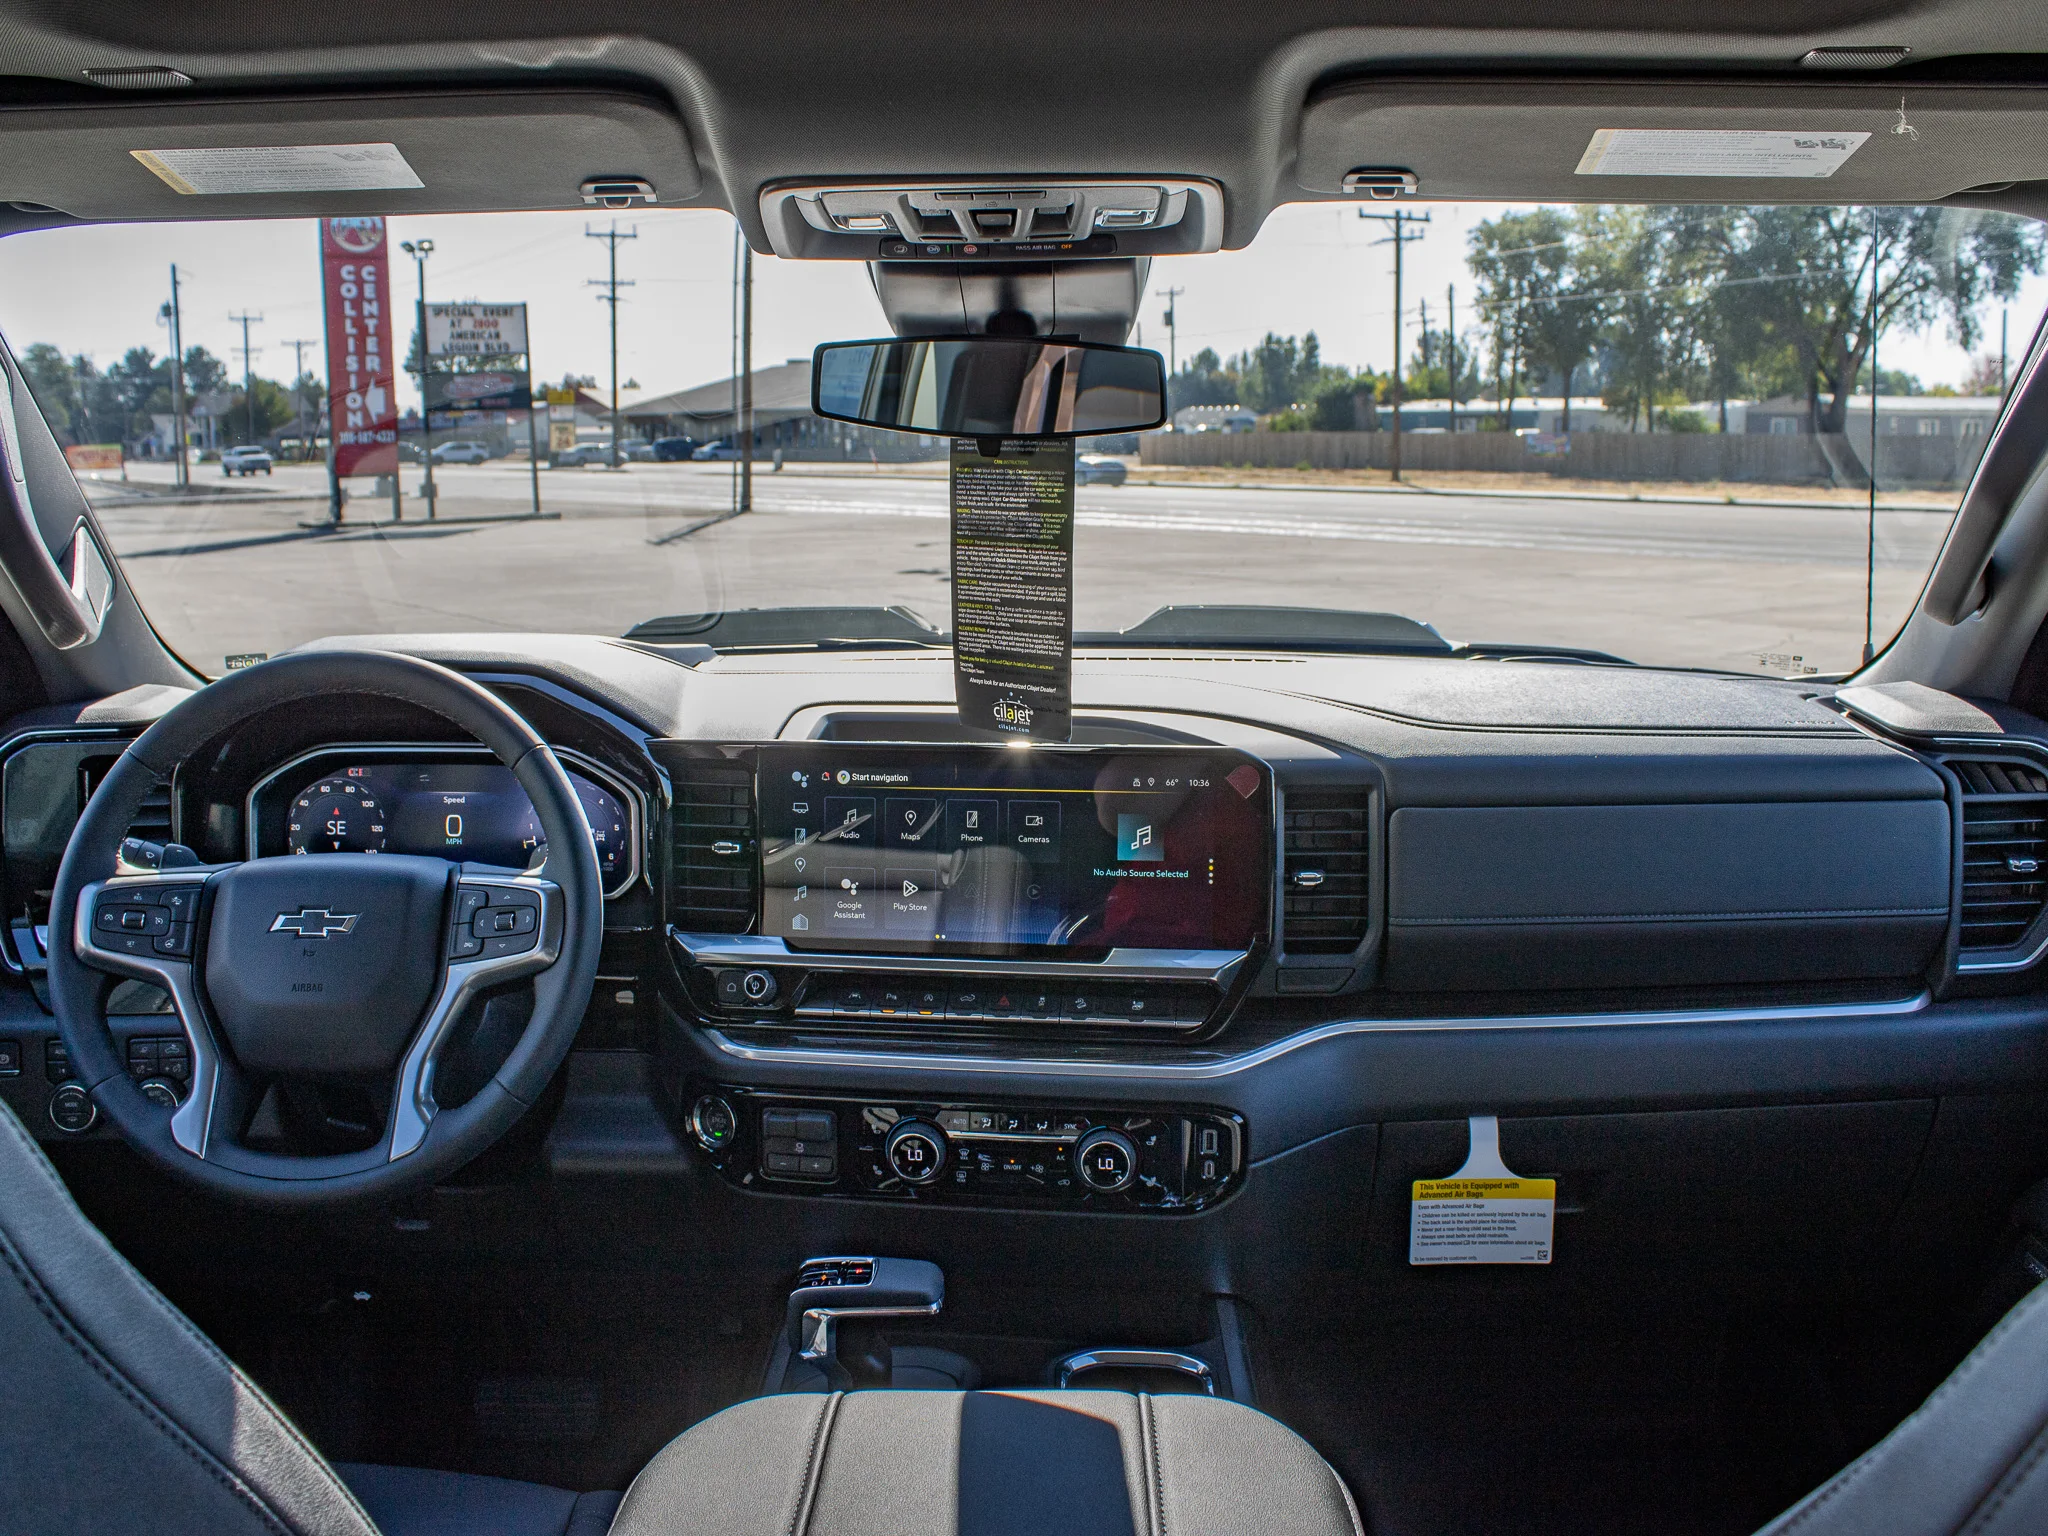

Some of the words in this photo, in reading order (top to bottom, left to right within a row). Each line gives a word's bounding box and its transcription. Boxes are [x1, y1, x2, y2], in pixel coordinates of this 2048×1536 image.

[432, 307, 475, 317] SPECIAL
[483, 307, 514, 317] EVENT
[361, 265, 382, 373] CENTER
[450, 319, 461, 329] AT
[450, 330, 501, 340] AMERICAN
[340, 264, 363, 427] COLLISION
[442, 342, 480, 353] LEGION
[484, 341, 510, 352] BLVD
[969, 677, 984, 685] Always
[1005, 682, 1026, 690] Authorized
[1027, 684, 1040, 693] Cilajet
[1040, 686, 1057, 694] Dealer!
[993, 704, 1031, 724] cilajet
[998, 724, 1030, 733] cilajet.com
[851, 773, 870, 781] Start
[870, 774, 908, 783] navigation
[1165, 778, 1179, 786] 66°
[1189, 779, 1210, 787] 10:36
[443, 796, 466, 805] Speed
[326, 820, 347, 835] SE
[445, 814, 463, 837] 0
[839, 831, 860, 839] Audio
[900, 833, 921, 841] Maps
[960, 833, 984, 842] Phone
[1018, 835, 1050, 844] Cameras
[608, 853, 615, 861] 6
[1093, 868, 1105, 876] No
[1106, 869, 1128, 877] Audio
[1129, 869, 1155, 878] Source
[1156, 870, 1189, 879] Selected
[837, 901, 862, 910] Google
[893, 903, 908, 912] Play
[908, 903, 928, 911] Store
[833, 911, 866, 919] Assistant
[291, 983, 323, 992] AIRBAG
[908, 1149, 923, 1161] LO
[1098, 1157, 1114, 1170] LO
[1419, 1183, 1434, 1191] This
[1470, 1182, 1503, 1190] Equipped
[1466, 1191, 1484, 1199] Bags
